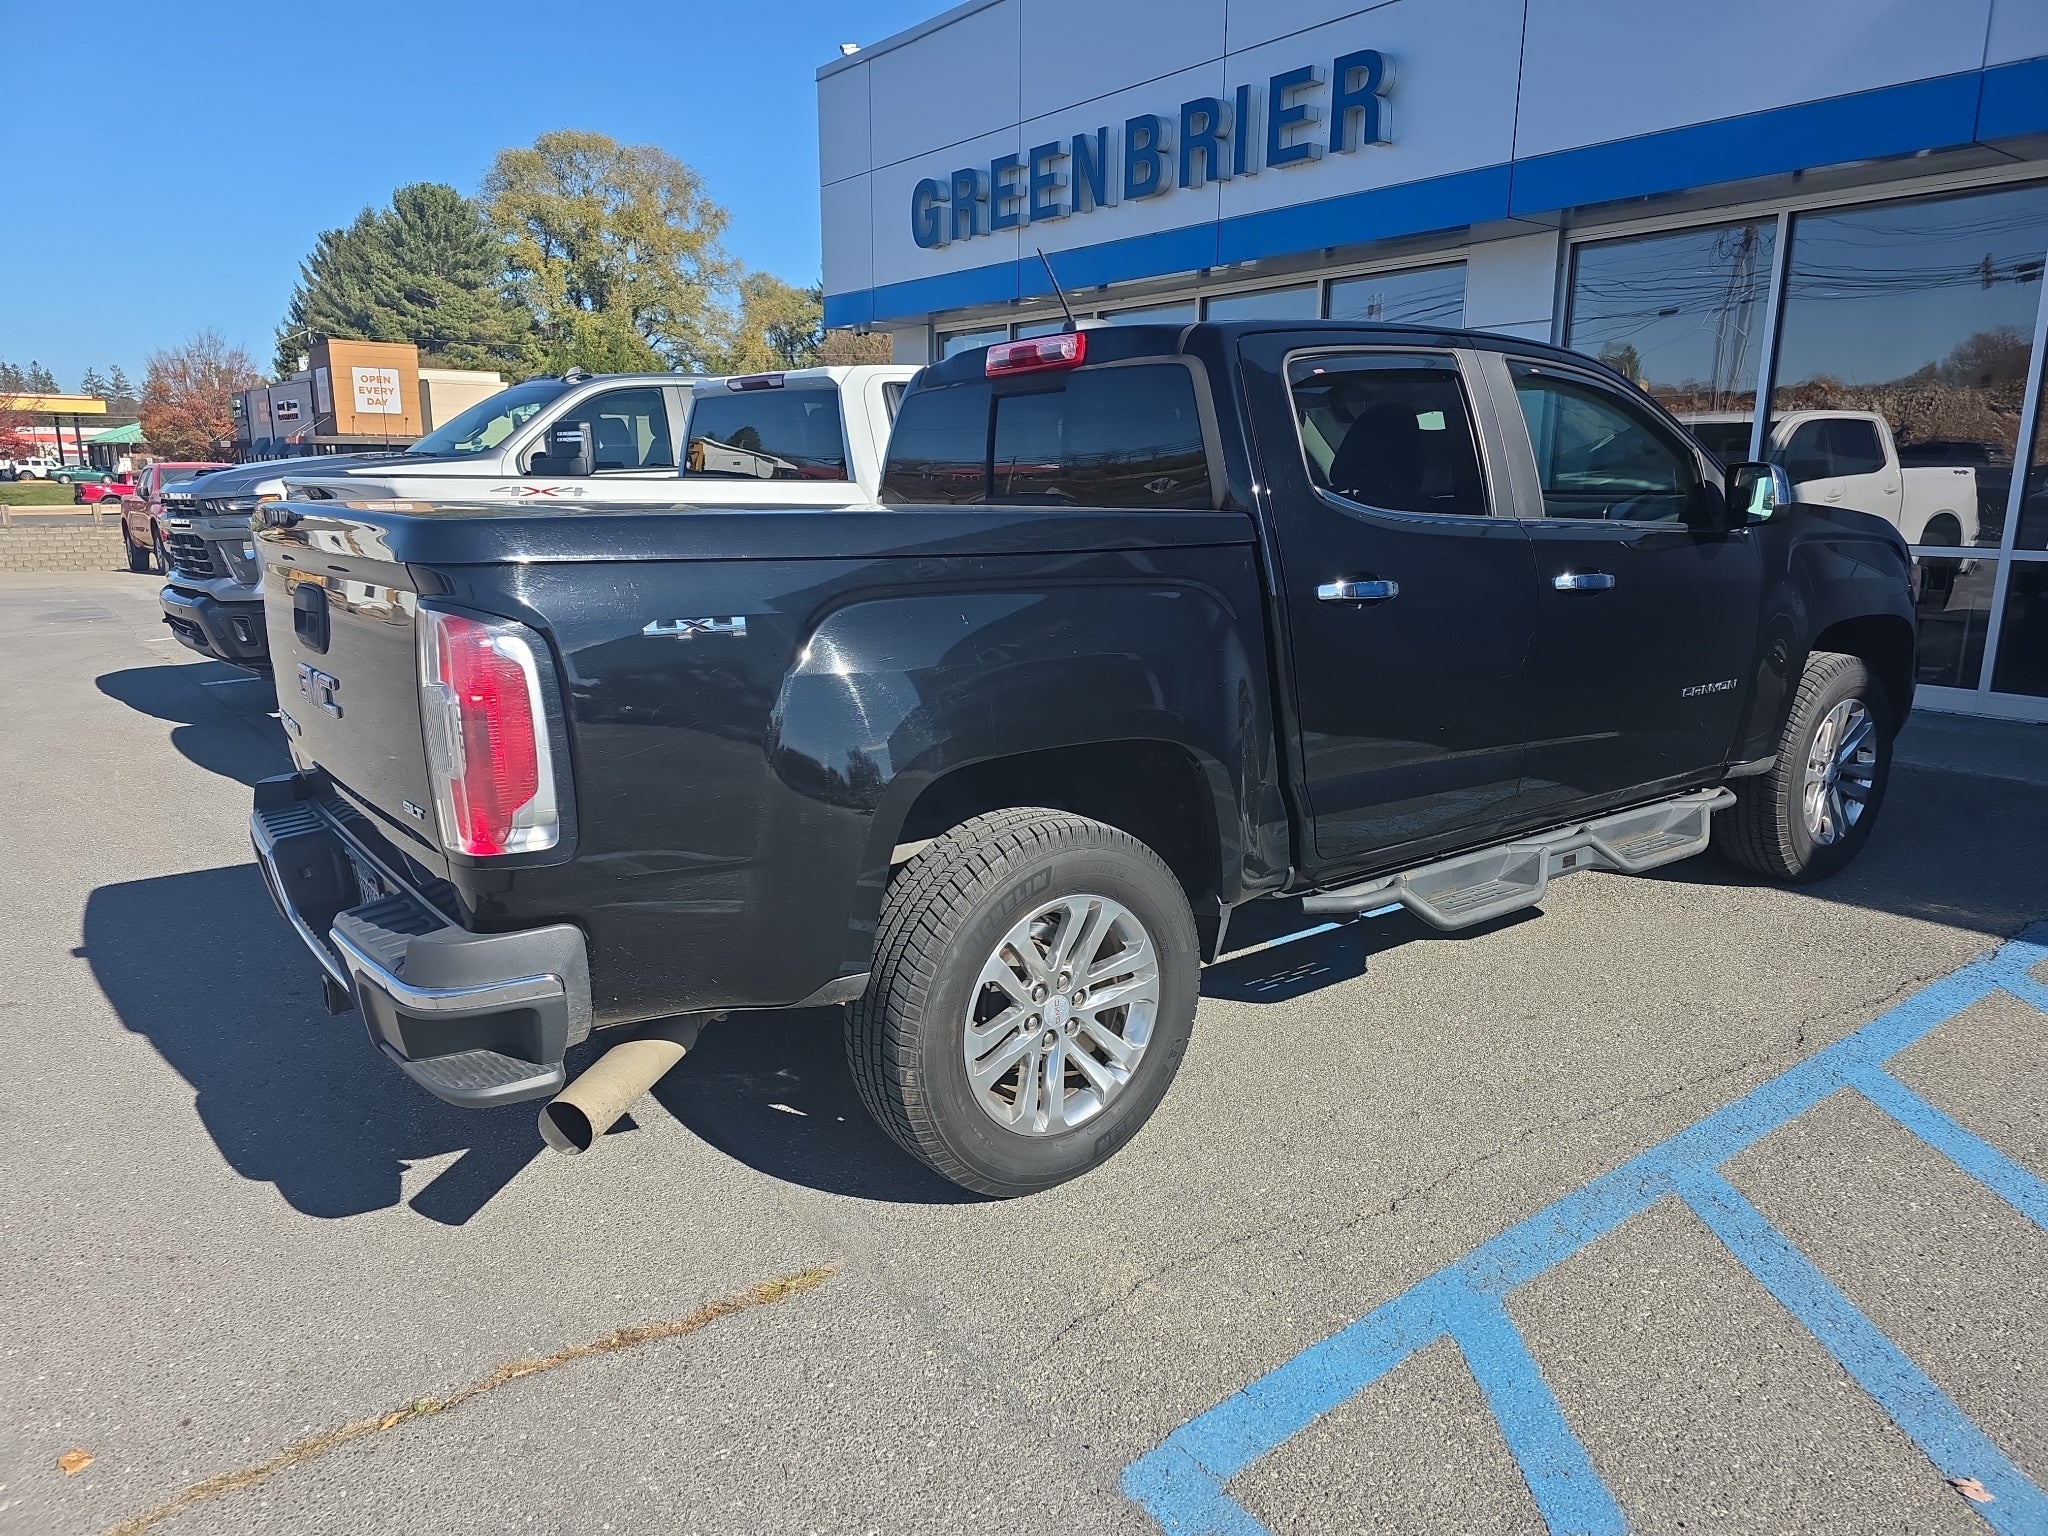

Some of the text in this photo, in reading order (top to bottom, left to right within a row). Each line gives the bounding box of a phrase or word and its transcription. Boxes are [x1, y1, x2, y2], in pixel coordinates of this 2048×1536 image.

[911, 48, 1396, 250] GREENBRIER
[360, 375, 391, 384] OPEN
[358, 386, 394, 395] EVERY
[366, 398, 389, 406] DAY
[1681, 679, 1738, 697] CANYON
[402, 797, 426, 820] SLT
[962, 869, 1049, 953] ICHELIN
